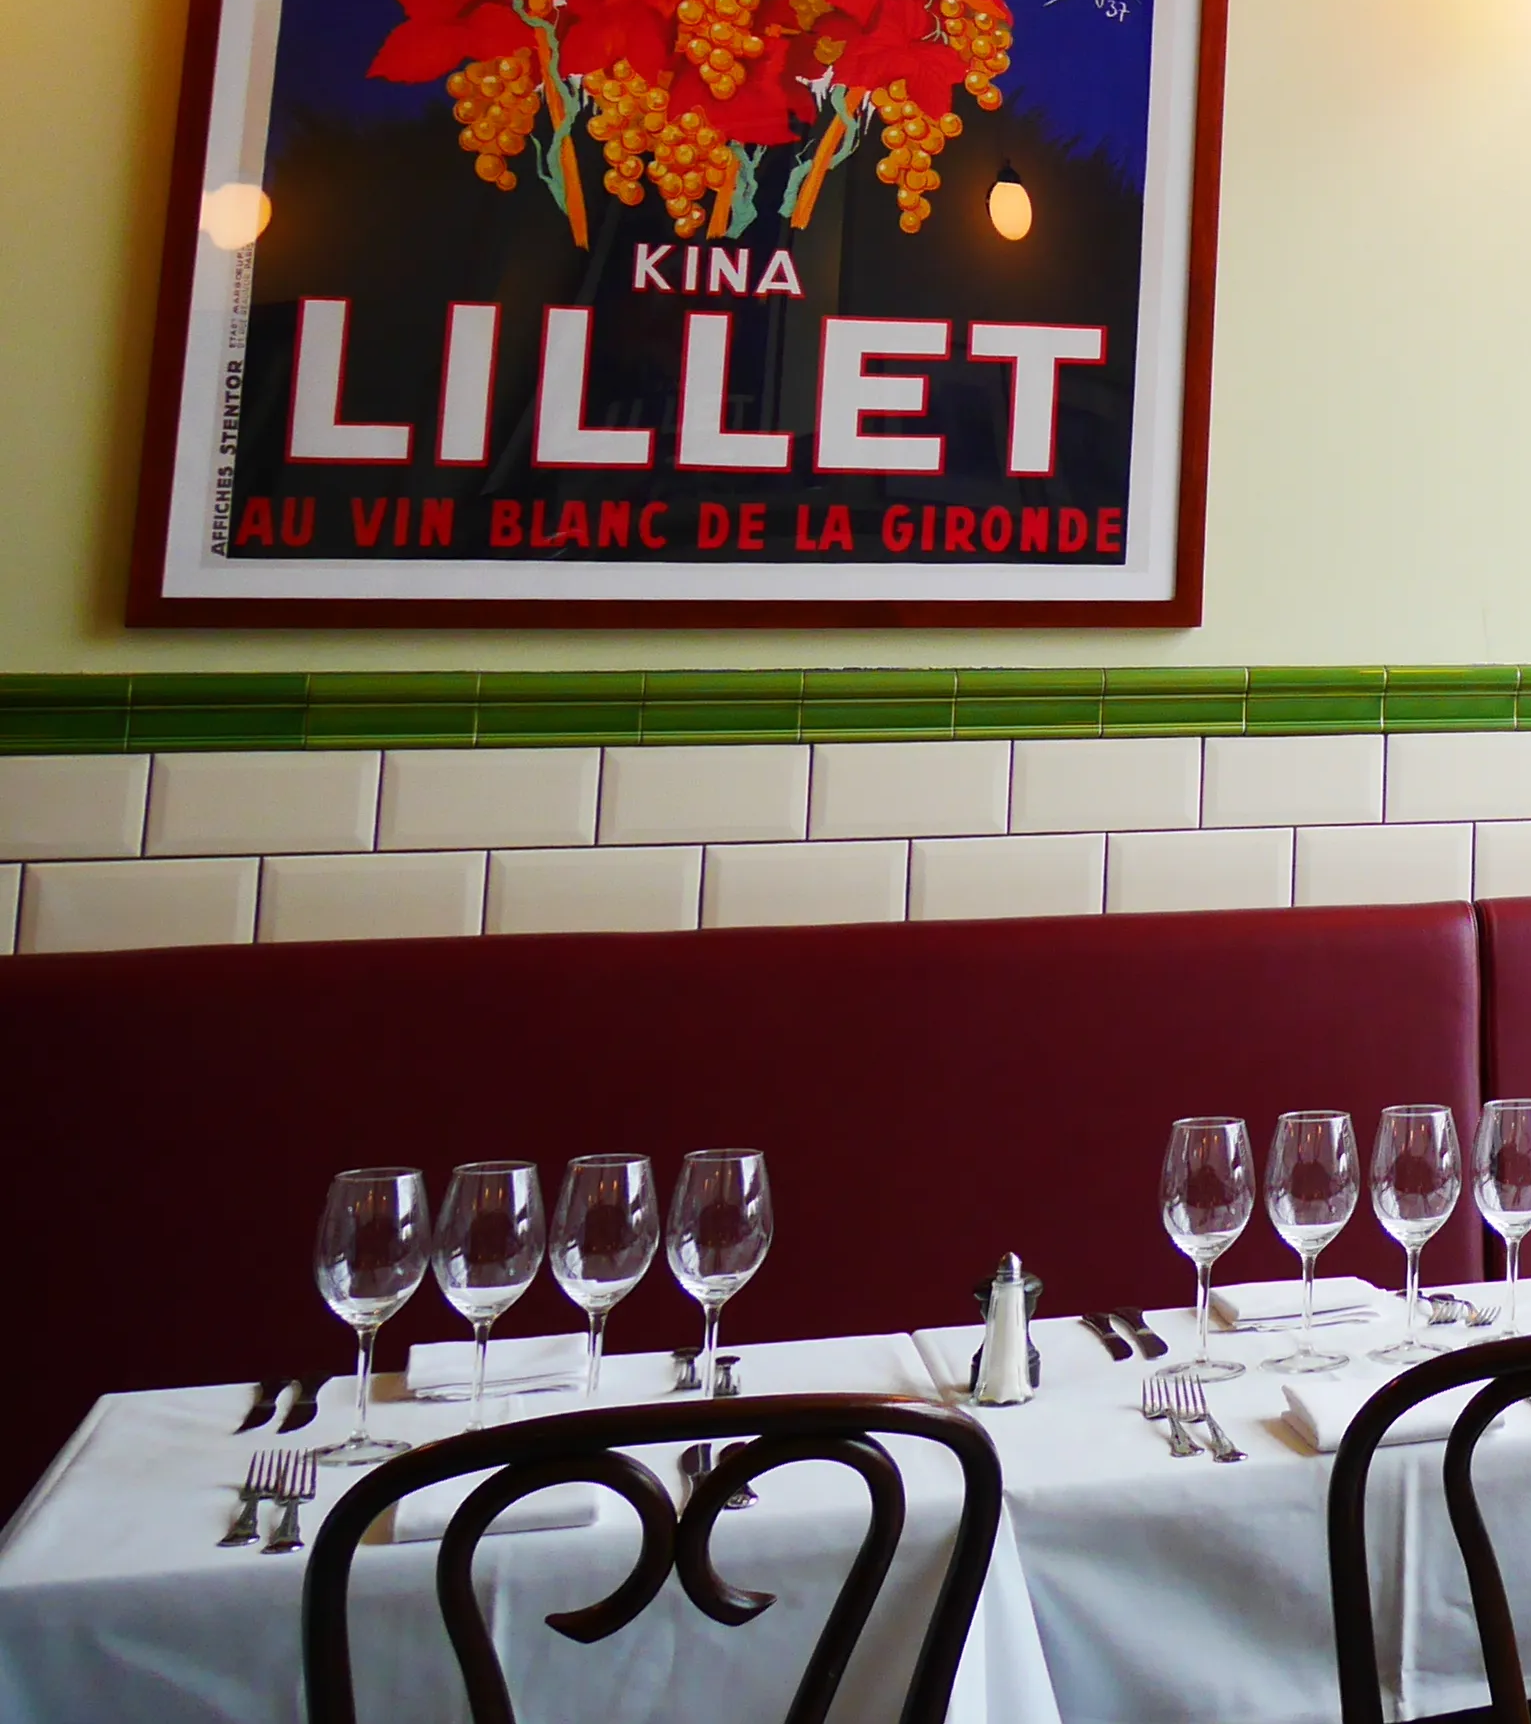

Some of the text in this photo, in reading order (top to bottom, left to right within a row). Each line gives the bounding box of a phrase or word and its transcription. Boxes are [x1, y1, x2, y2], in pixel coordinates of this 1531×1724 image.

[632, 242, 803, 298] KINA
[285, 295, 1108, 476] LILLET
[211, 359, 243, 557] AFFICHES STENTOR
[235, 497, 1121, 552] AU VIN BLANC DE LA GIRONDE
